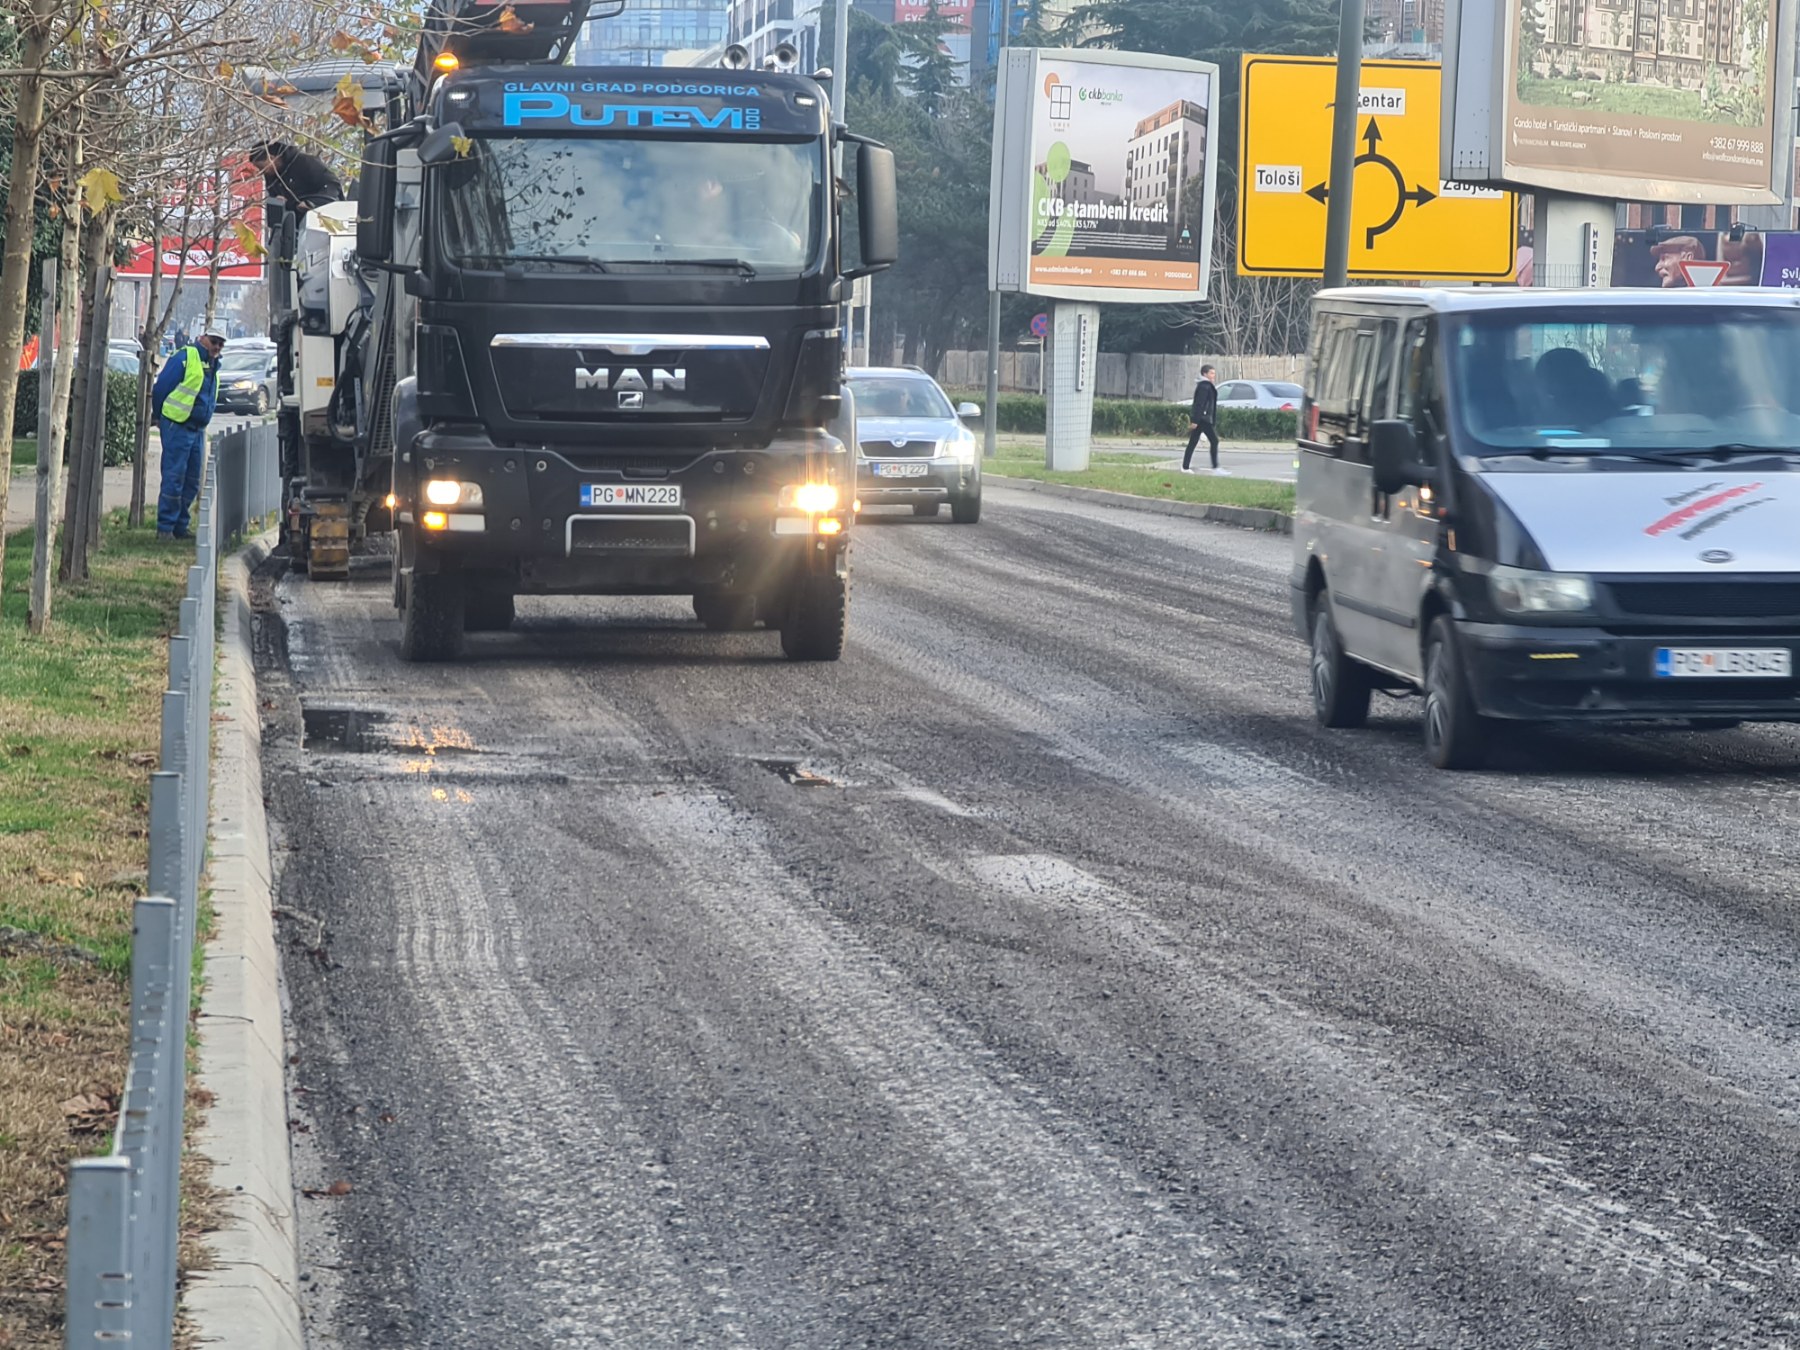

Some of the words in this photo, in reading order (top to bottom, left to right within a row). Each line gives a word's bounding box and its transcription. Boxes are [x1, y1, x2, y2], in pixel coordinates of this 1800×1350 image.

[504, 82, 575, 93] GLAVNI
[581, 82, 636, 93] GRAD
[642, 83, 760, 96] PODGORICA
[1513, 117, 1532, 128] Condo
[1533, 118, 1547, 129] hotel
[1578, 123, 1606, 135] apartmani
[1612, 125, 1632, 137] Stanovi
[1638, 128, 1660, 140] Poslovni
[1661, 131, 1682, 142] prostori
[1709, 137, 1726, 149] +382
[1727, 138, 1736, 150] 67
[1736, 139, 1750, 152] 999
[1750, 141, 1764, 153] 888
[1256, 169, 1301, 187] Tološi
[1038, 197, 1064, 217] CKB
[1067, 199, 1127, 220] stambeni
[1129, 202, 1169, 223] kredit
[575, 368, 686, 391] MAN
[881, 464, 892, 473] PG
[593, 487, 614, 504] PG
